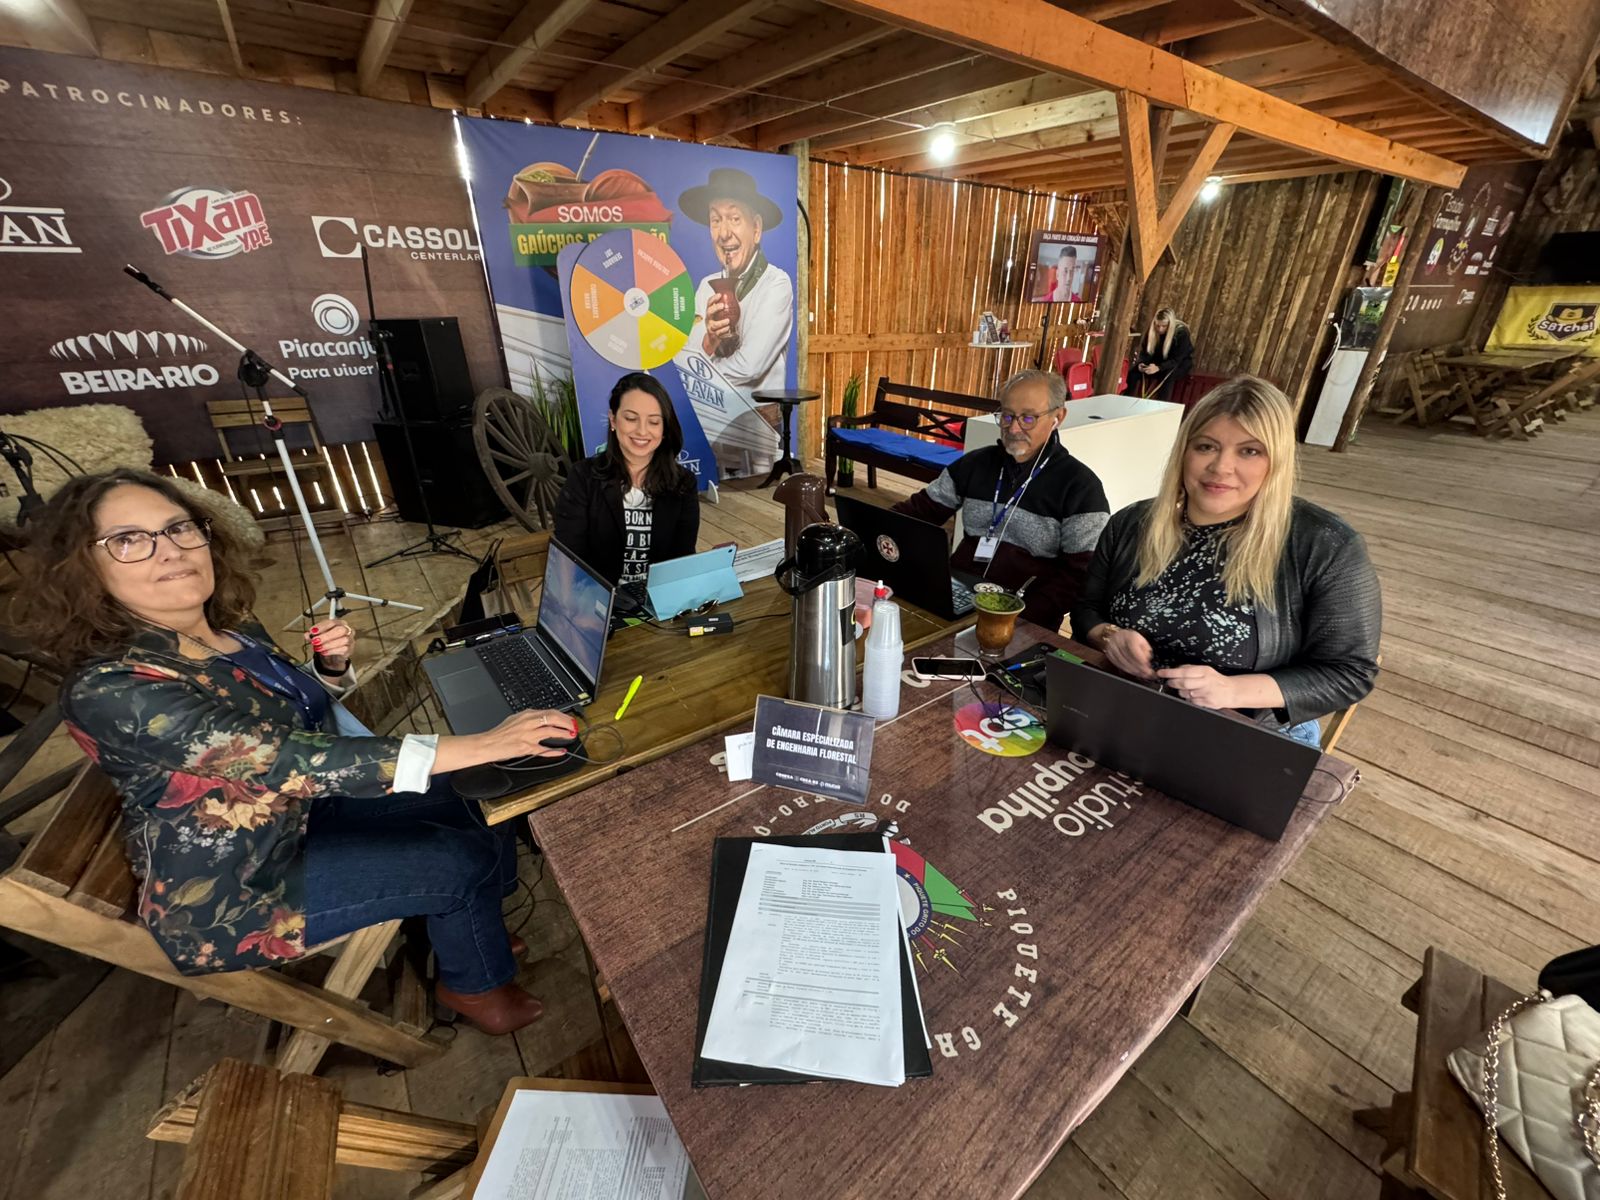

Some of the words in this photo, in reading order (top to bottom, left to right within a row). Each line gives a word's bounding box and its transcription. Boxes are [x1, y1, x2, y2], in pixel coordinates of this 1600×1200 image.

[557, 205, 624, 223] SOMOS
[363, 224, 479, 251] CASSOL
[410, 252, 481, 261] CENTERLAR
[60, 364, 220, 395] BEIRA-RIO
[288, 366, 331, 380] Para
[334, 363, 374, 377] viver
[624, 510, 653, 526] BORN
[771, 725, 801, 741] CÂMARA
[802, 731, 854, 751] ESPECIALIZADA
[766, 738, 776, 749] DE
[776, 739, 818, 757] ENGENHARIA
[819, 749, 857, 765] FLORESTAL
[976, 751, 1096, 834] oupilha
[1052, 771, 1143, 837] túdio
[913, 882, 929, 908] PIQUETE
[917, 908, 929, 928] GRITO
[910, 926, 922, 937] DO
[996, 888, 1038, 1028] PIQUETE
